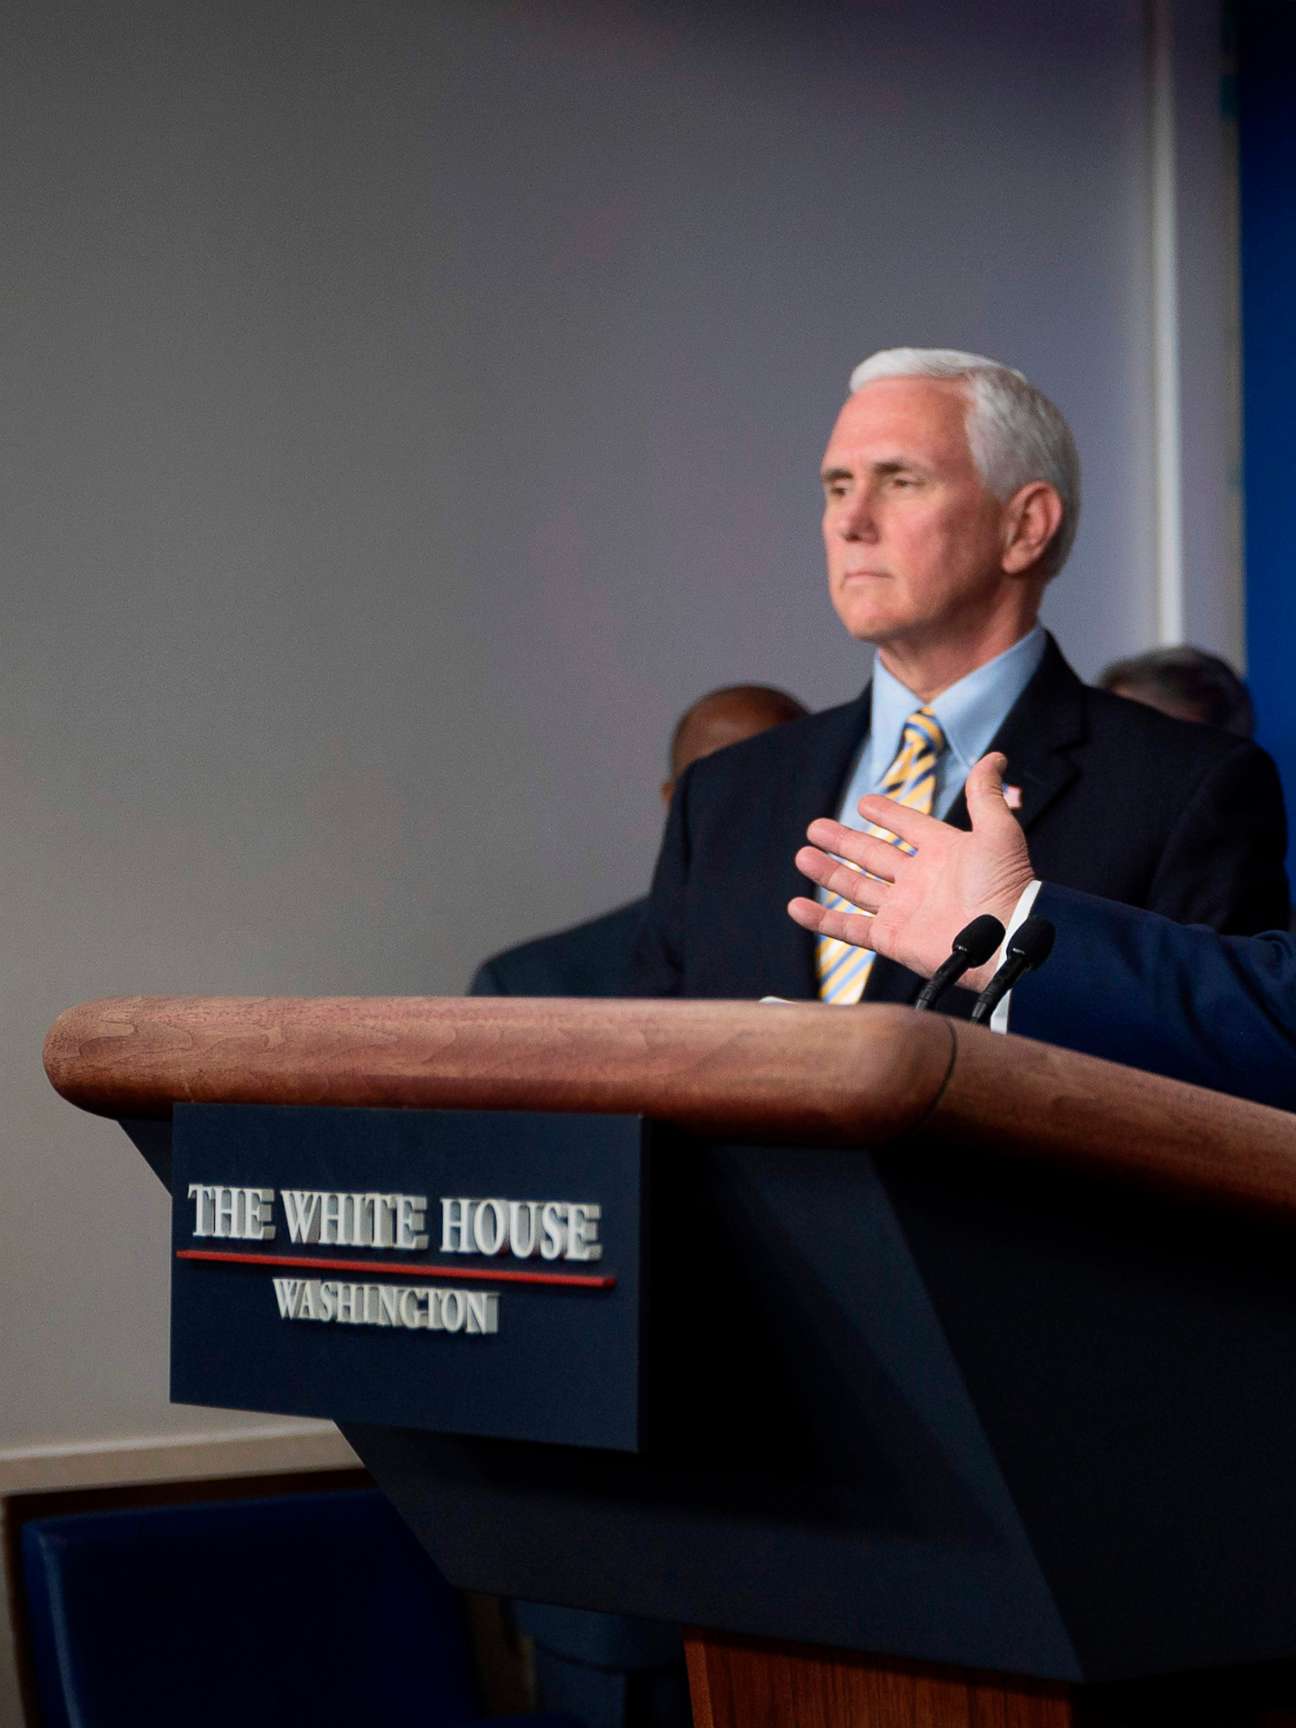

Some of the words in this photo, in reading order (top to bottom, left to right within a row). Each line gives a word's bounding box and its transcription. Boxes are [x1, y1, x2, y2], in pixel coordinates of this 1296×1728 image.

[188, 1184, 276, 1240] THE
[280, 1190, 429, 1249] WHITE
[440, 1198, 603, 1261] HOUSE
[273, 1277, 500, 1335] WASHINGTON
